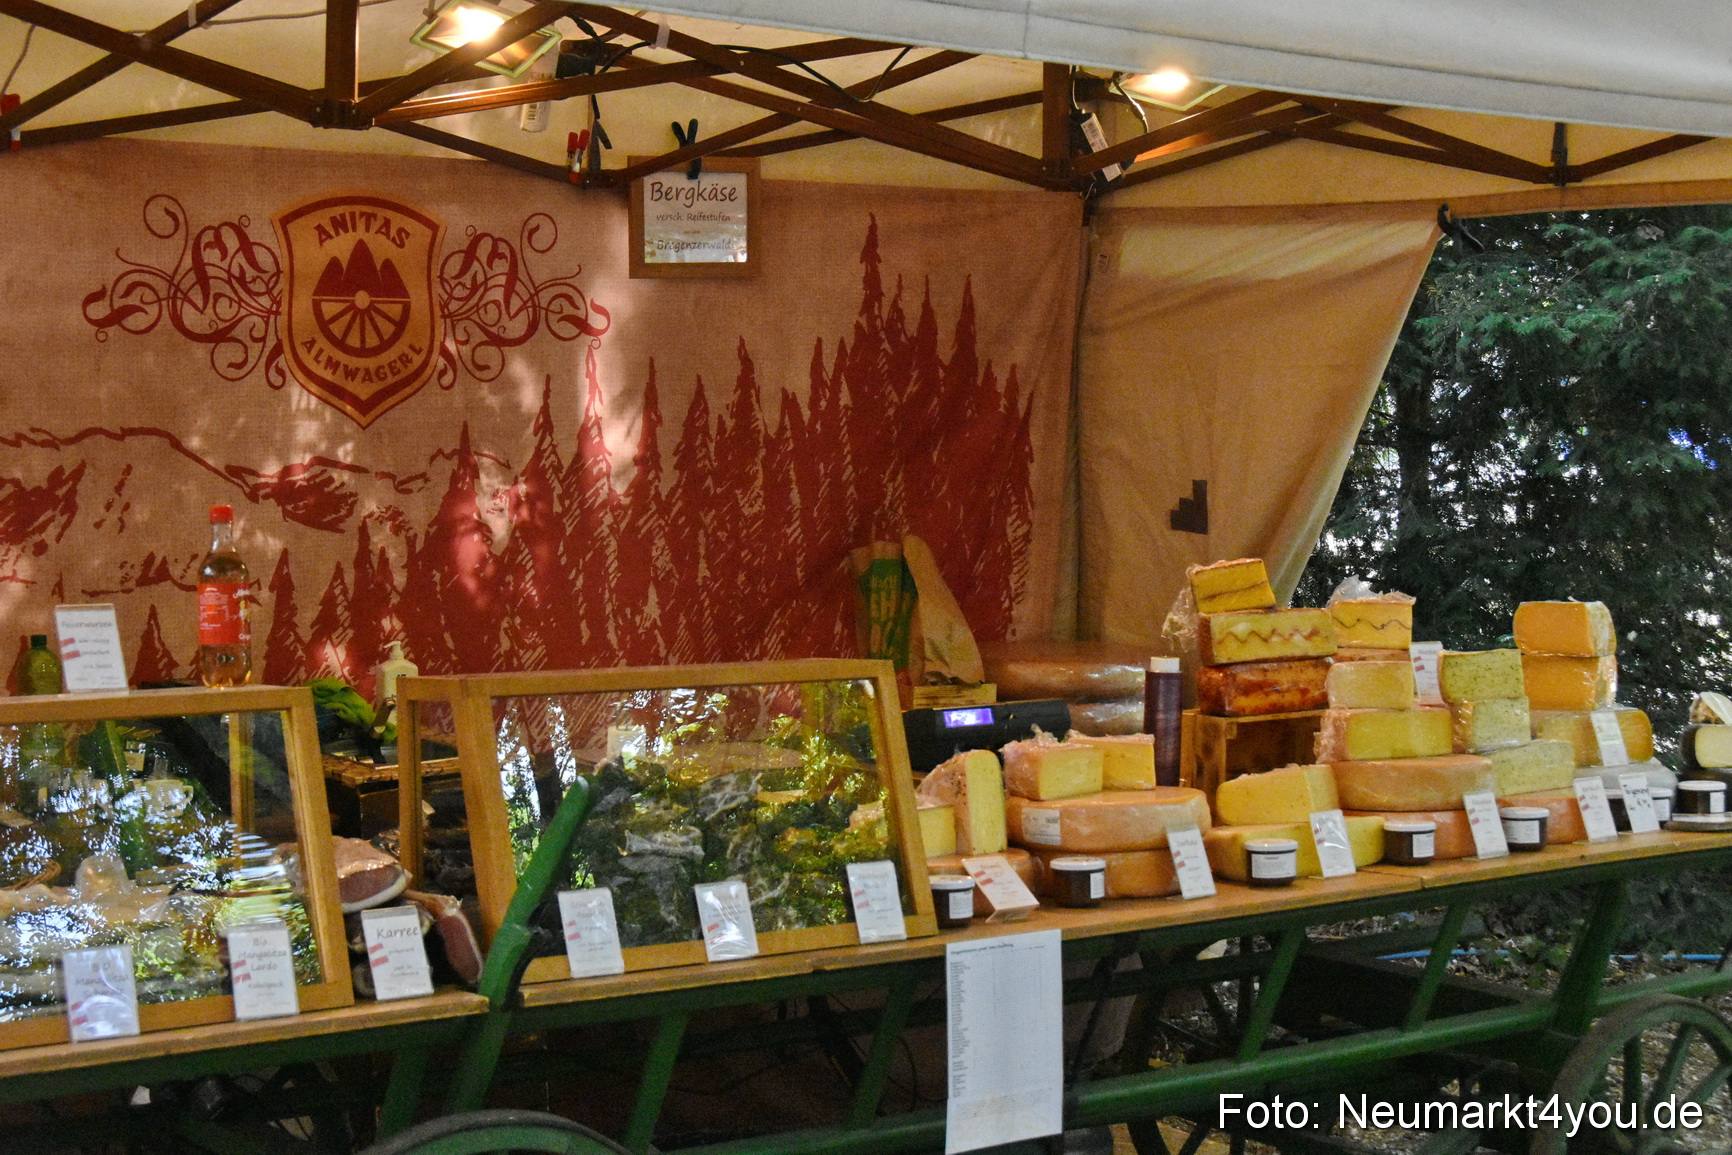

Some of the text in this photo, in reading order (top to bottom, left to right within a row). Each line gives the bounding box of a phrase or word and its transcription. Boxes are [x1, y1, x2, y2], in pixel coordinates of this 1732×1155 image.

[650, 180, 738, 208] Bergkäse
[313, 210, 411, 249] ANITAS
[301, 336, 423, 384] ALMWAGERL
[377, 926, 419, 939] Karree
